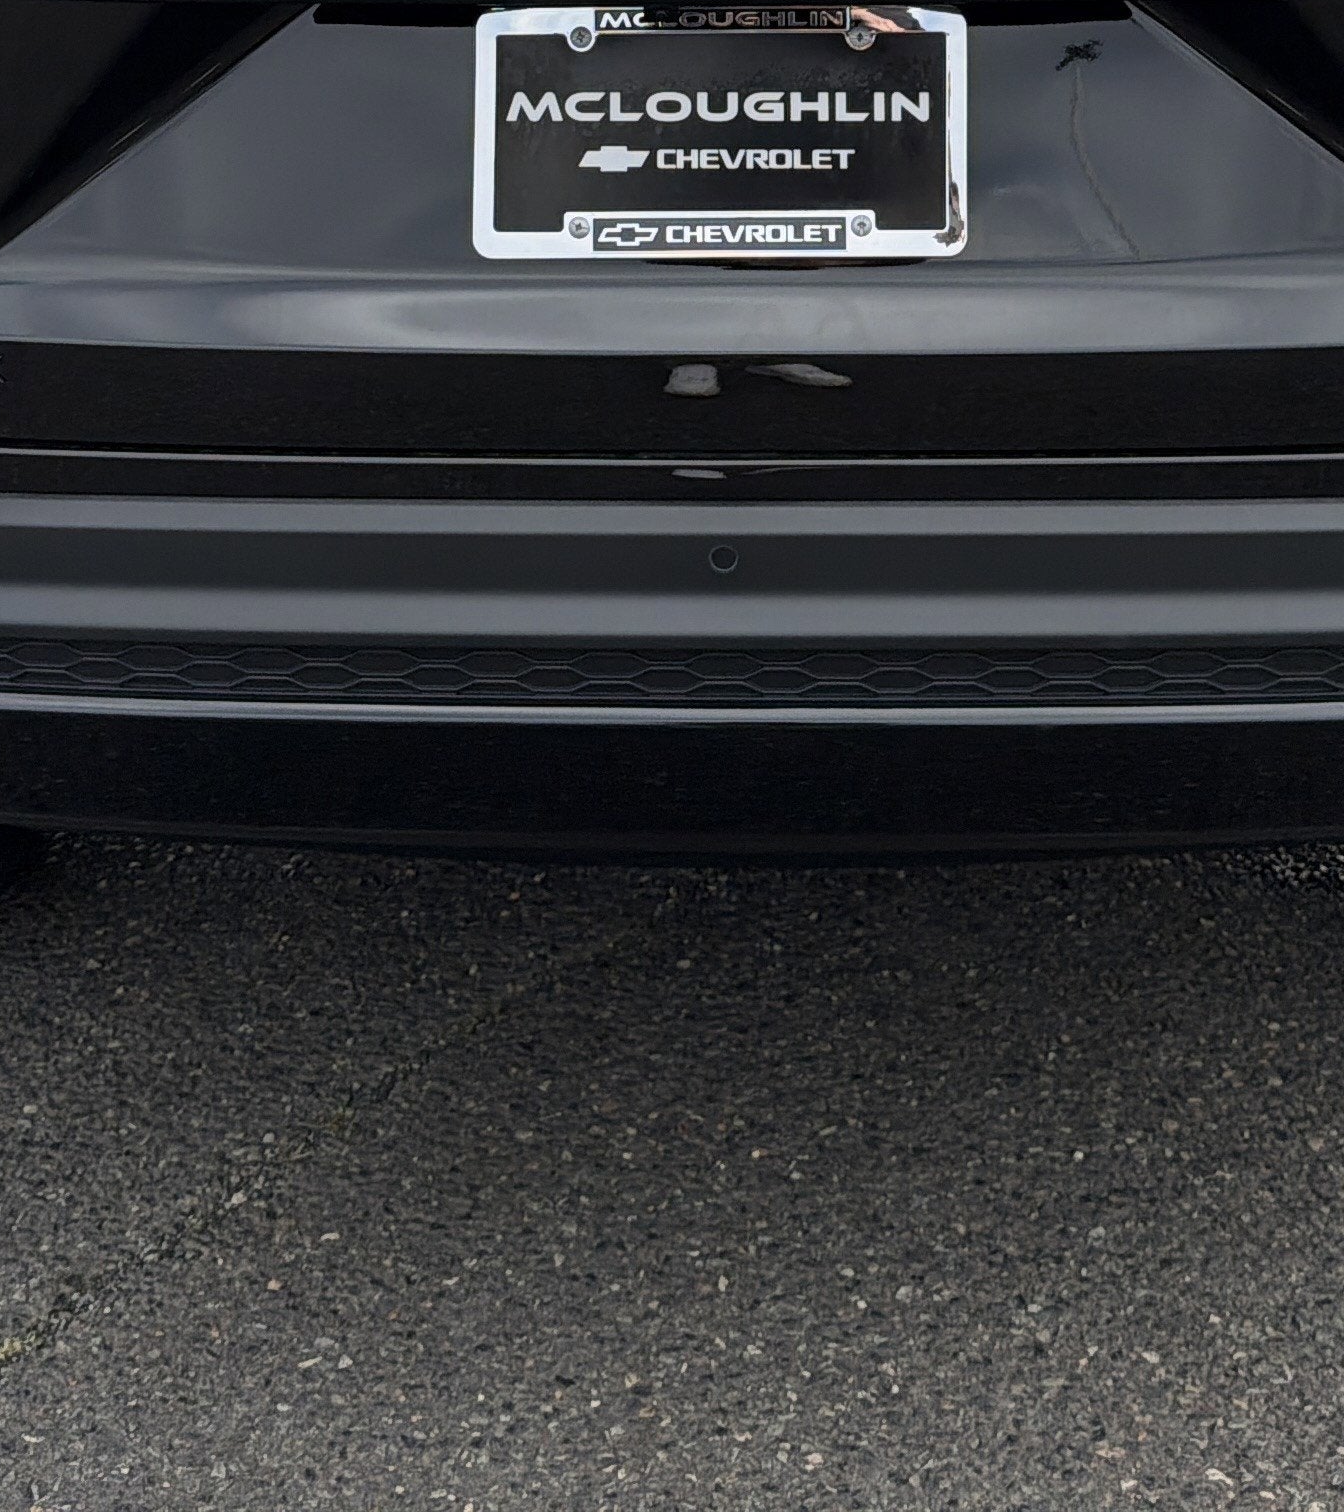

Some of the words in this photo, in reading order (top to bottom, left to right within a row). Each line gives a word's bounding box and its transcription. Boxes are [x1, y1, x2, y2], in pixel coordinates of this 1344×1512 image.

[599, 10, 844, 28] MCLOUGHLIN
[505, 90, 931, 123] MCLOUGHLIN
[656, 147, 856, 171] CHEVROLET
[664, 224, 843, 245] CHEVROLET
